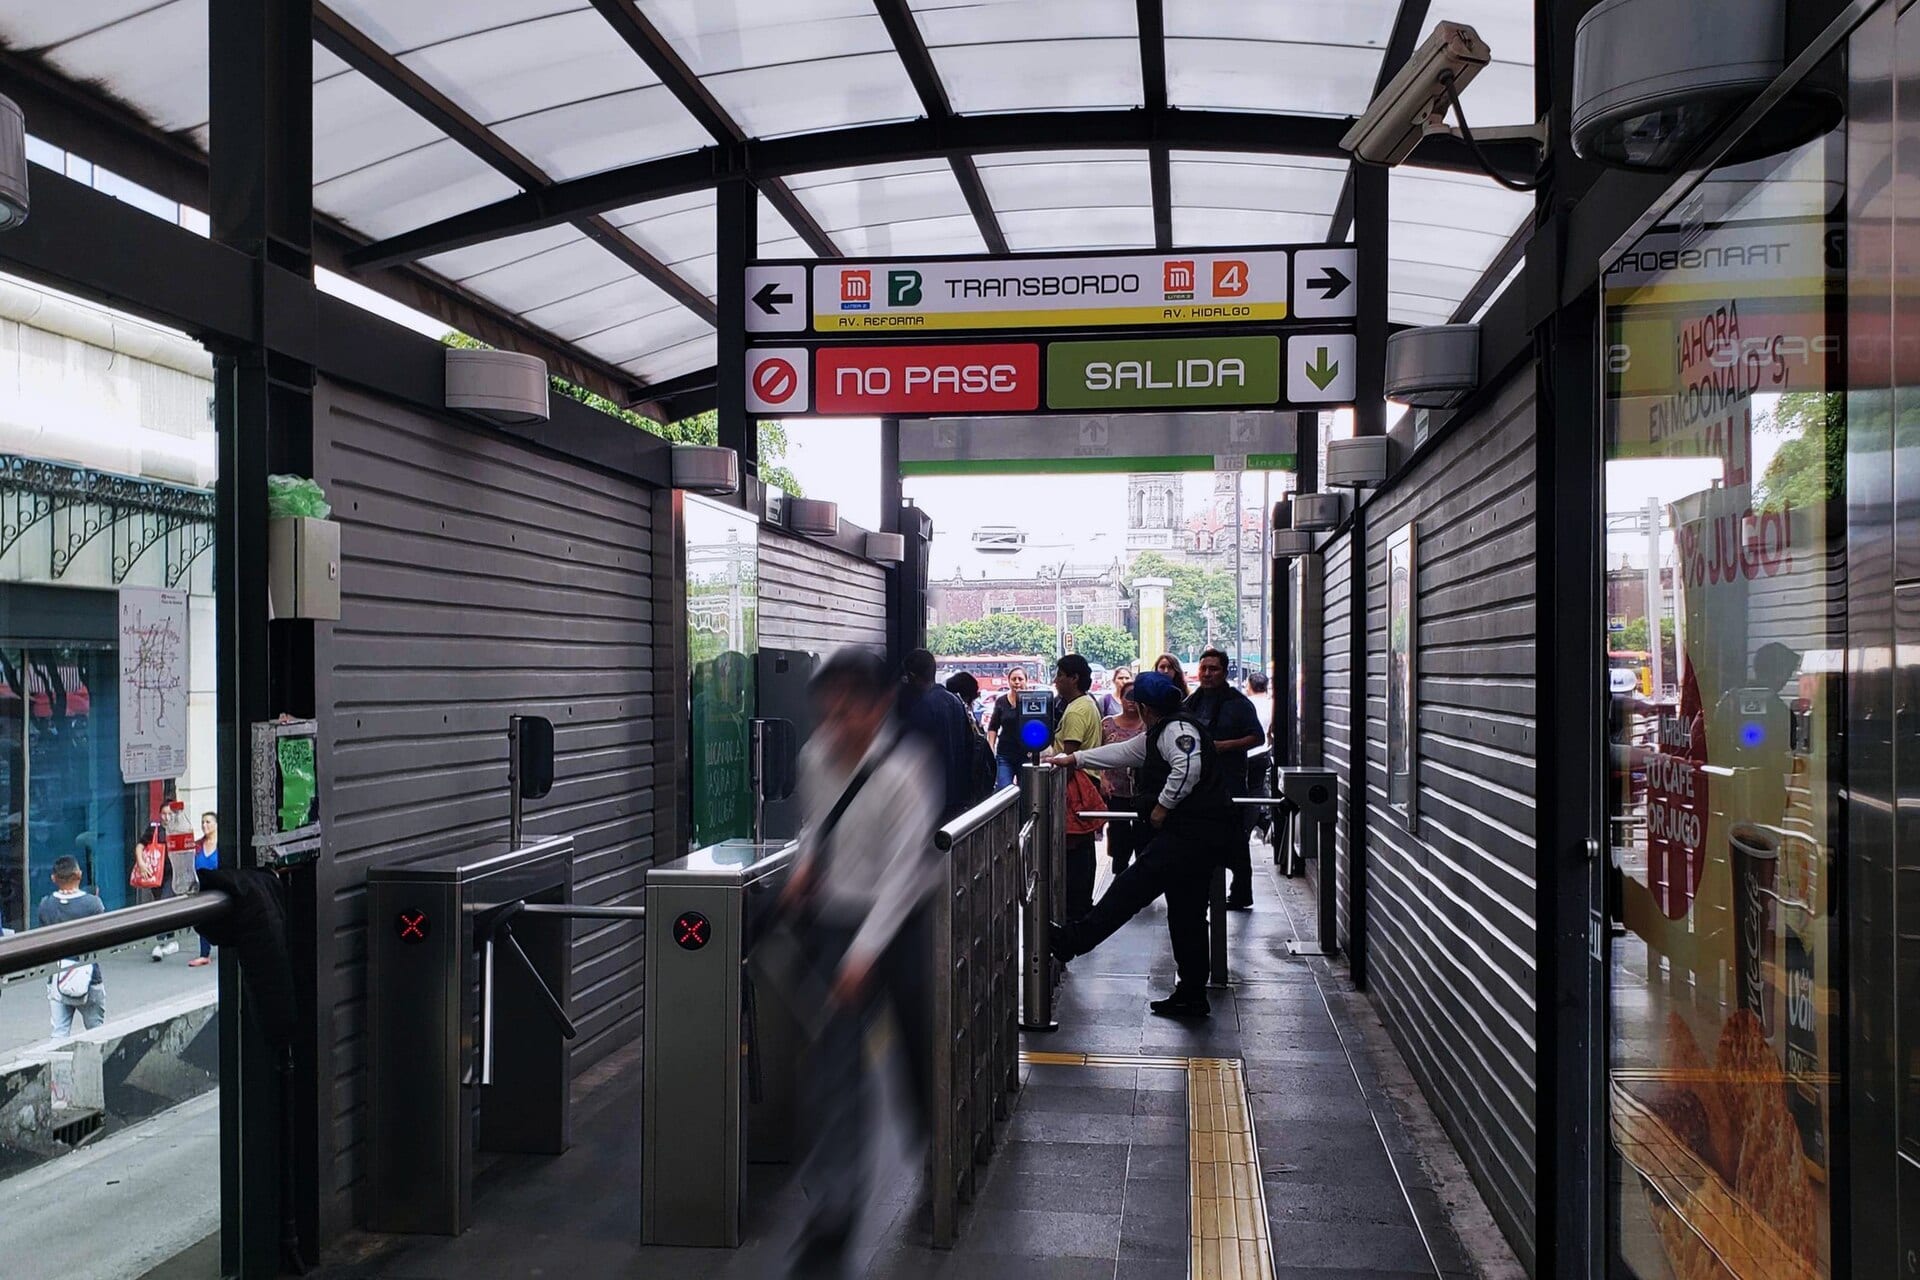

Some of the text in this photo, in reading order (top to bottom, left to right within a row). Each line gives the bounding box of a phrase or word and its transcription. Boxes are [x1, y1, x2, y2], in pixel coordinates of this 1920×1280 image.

[944, 273, 1140, 299] TRANSBORDO
[839, 316, 925, 327] AV. REFORMA
[1163, 306, 1250, 318] AV. HIDALGO
[836, 364, 1017, 395] NO PASE
[1085, 358, 1245, 391] SALIDA
[1650, 401, 1669, 443] EN
[1707, 498, 1793, 585] JUGO!
[1643, 755, 1661, 789] TU
[1666, 809, 1700, 848] JUGO
